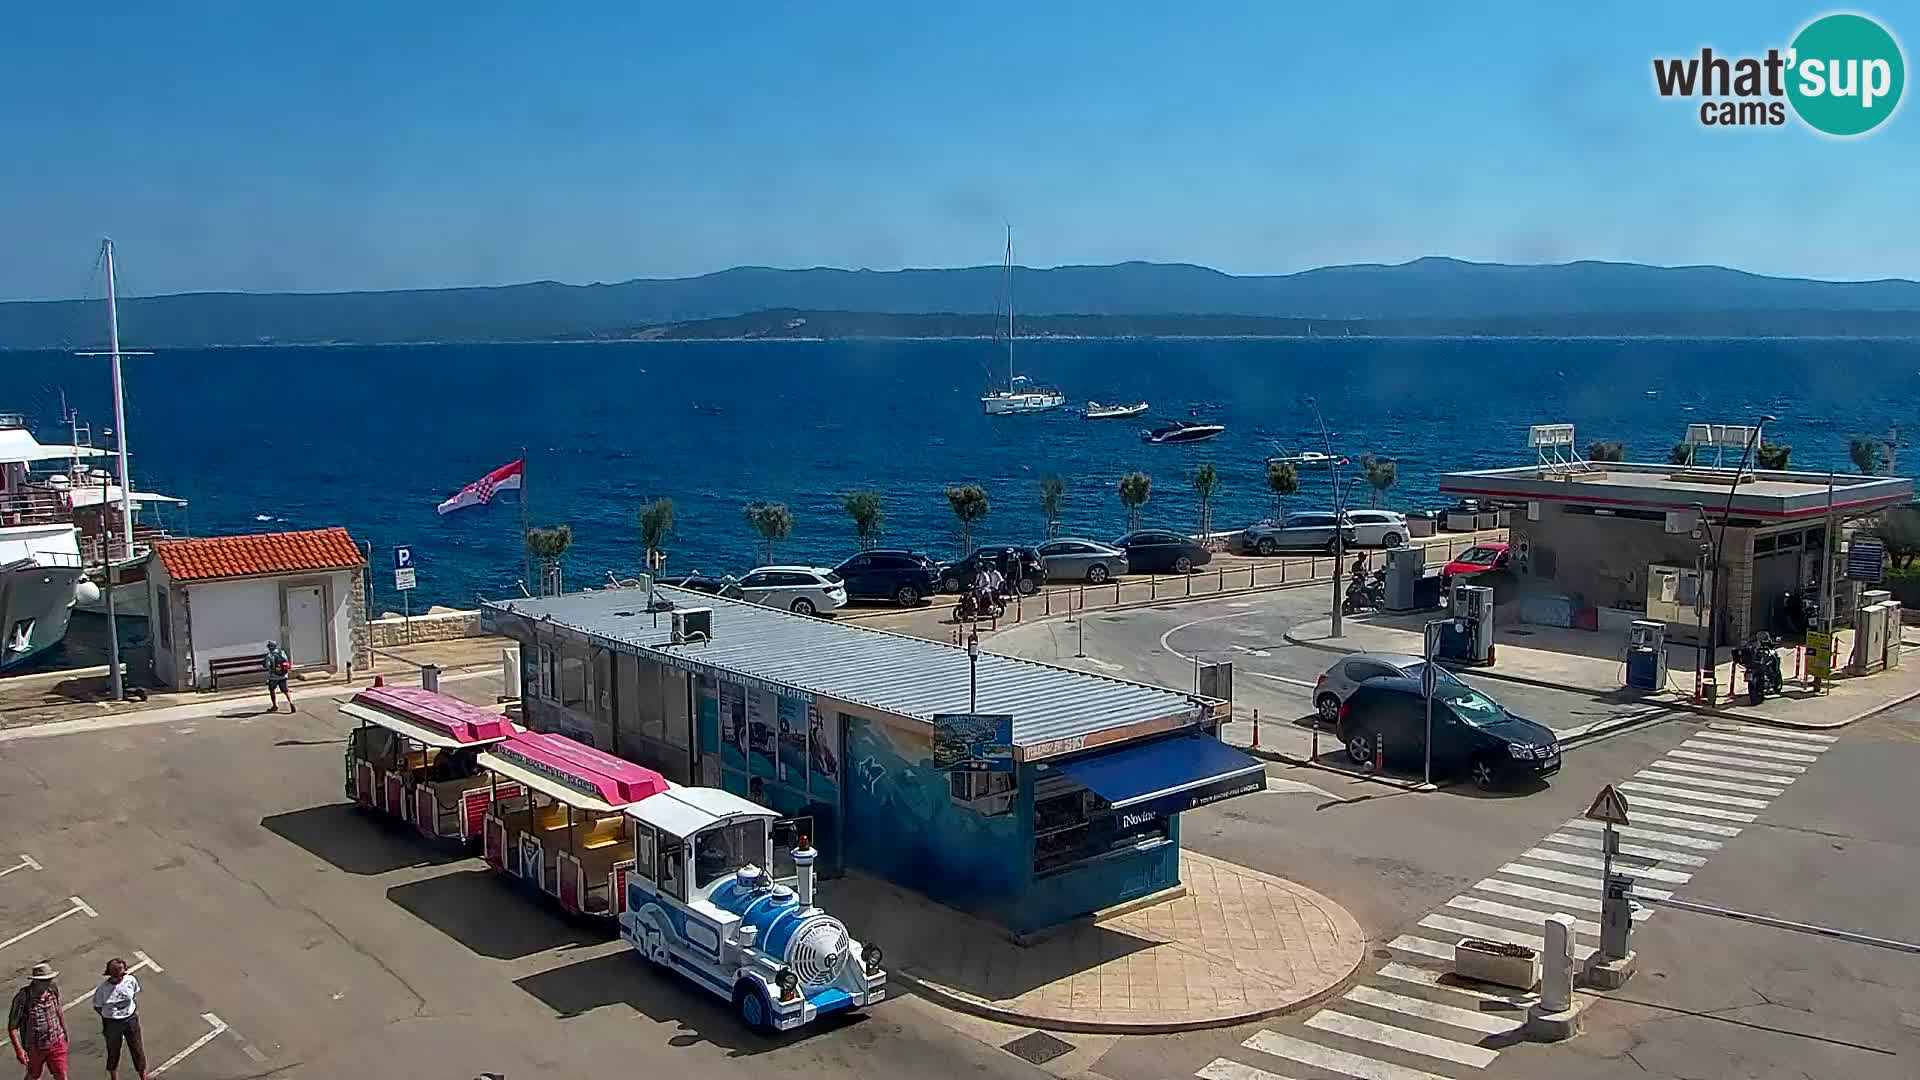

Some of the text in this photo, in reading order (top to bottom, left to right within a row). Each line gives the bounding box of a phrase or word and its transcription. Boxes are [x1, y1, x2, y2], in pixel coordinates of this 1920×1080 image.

[398, 549, 410, 567] P
[675, 659, 704, 673] POSTAJA
[729, 674, 759, 688] STATION
[761, 681, 786, 696] TICKET
[787, 688, 813, 702] OFFICE
